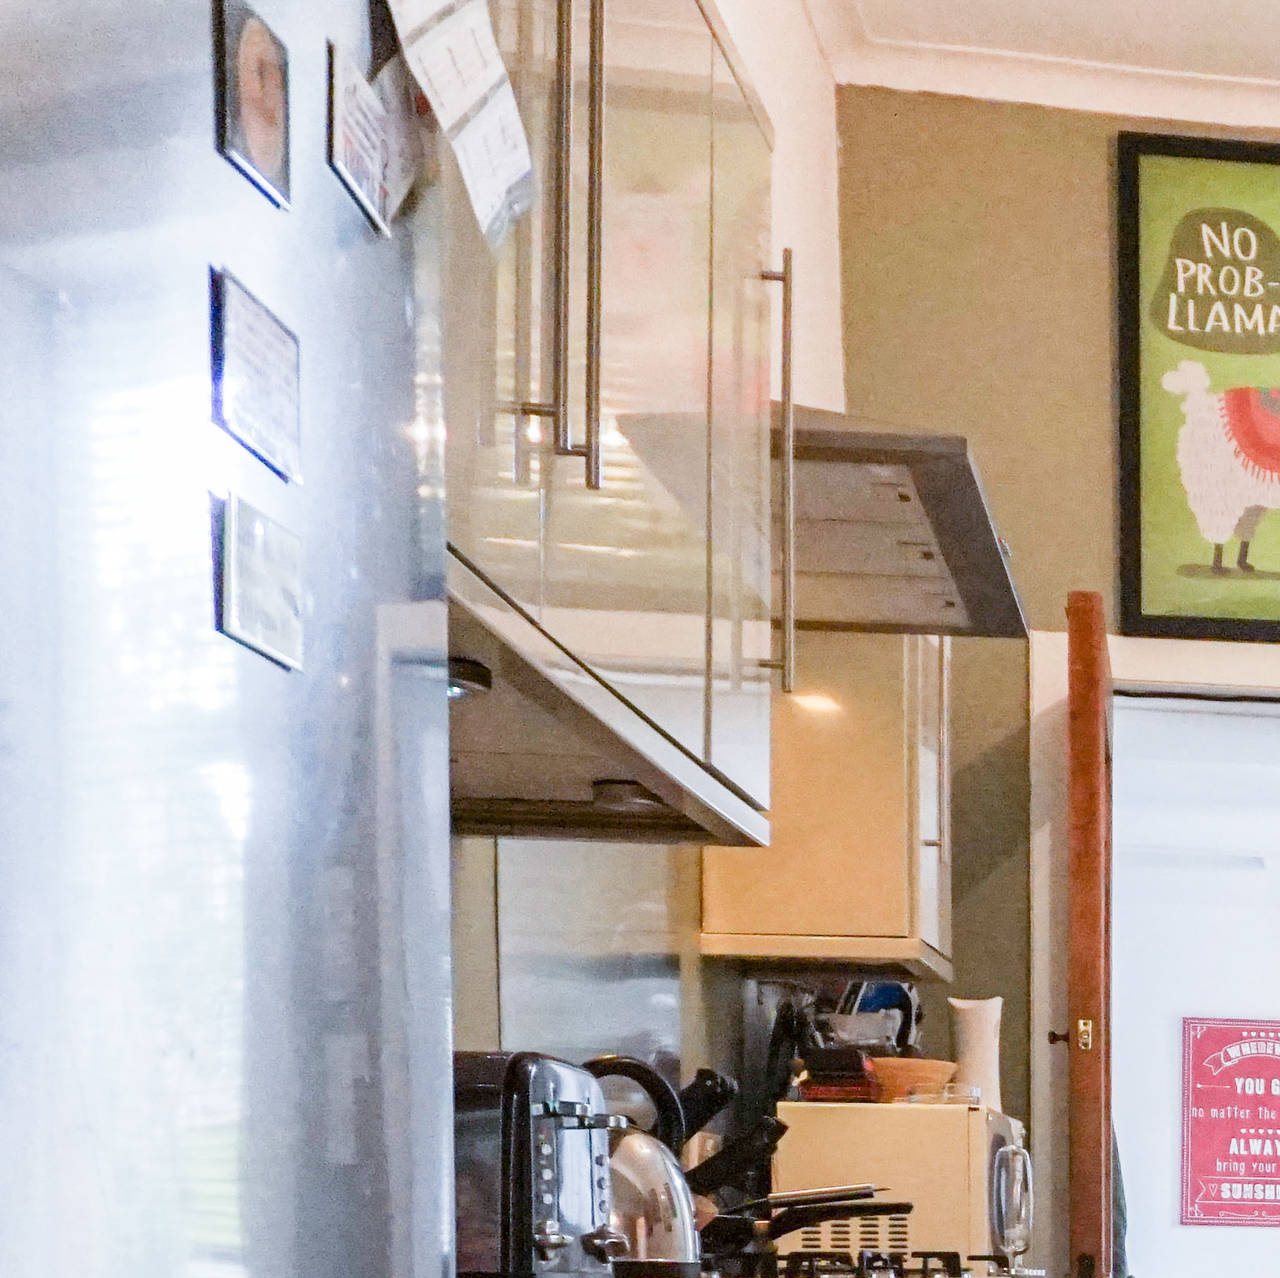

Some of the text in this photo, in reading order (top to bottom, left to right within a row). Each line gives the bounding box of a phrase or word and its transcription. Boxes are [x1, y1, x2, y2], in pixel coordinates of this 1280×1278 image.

[1201, 221, 1257, 261] NO
[1175, 258, 1280, 297] PROB-
[1234, 1077, 1266, 1095] YOU
[1191, 1106, 1205, 1118] no
[1210, 1106, 1251, 1120] matter
[1257, 1106, 1277, 1120] the
[1216, 1158, 1246, 1176] bring
[1252, 1161, 1277, 1174] your
